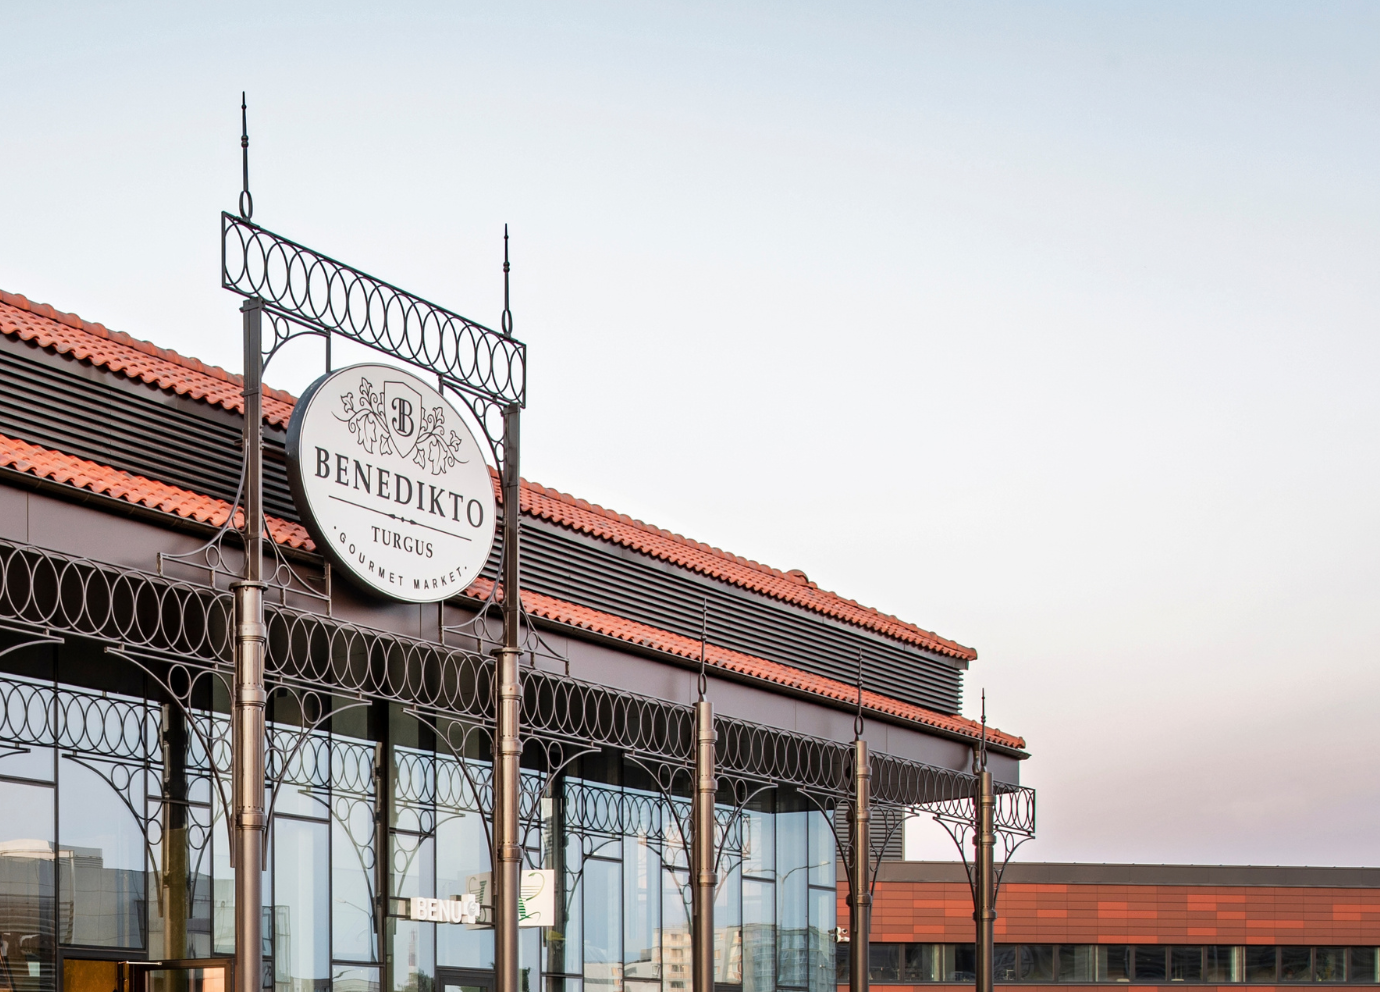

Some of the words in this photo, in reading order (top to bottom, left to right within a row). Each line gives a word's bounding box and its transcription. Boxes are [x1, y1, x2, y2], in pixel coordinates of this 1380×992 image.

[314, 446, 484, 528] BENEDIKTO
[339, 532, 404, 586] GOURMET
[413, 566, 461, 590] MARKET
[371, 525, 434, 559] TURGUS
[416, 897, 462, 923] BENU
